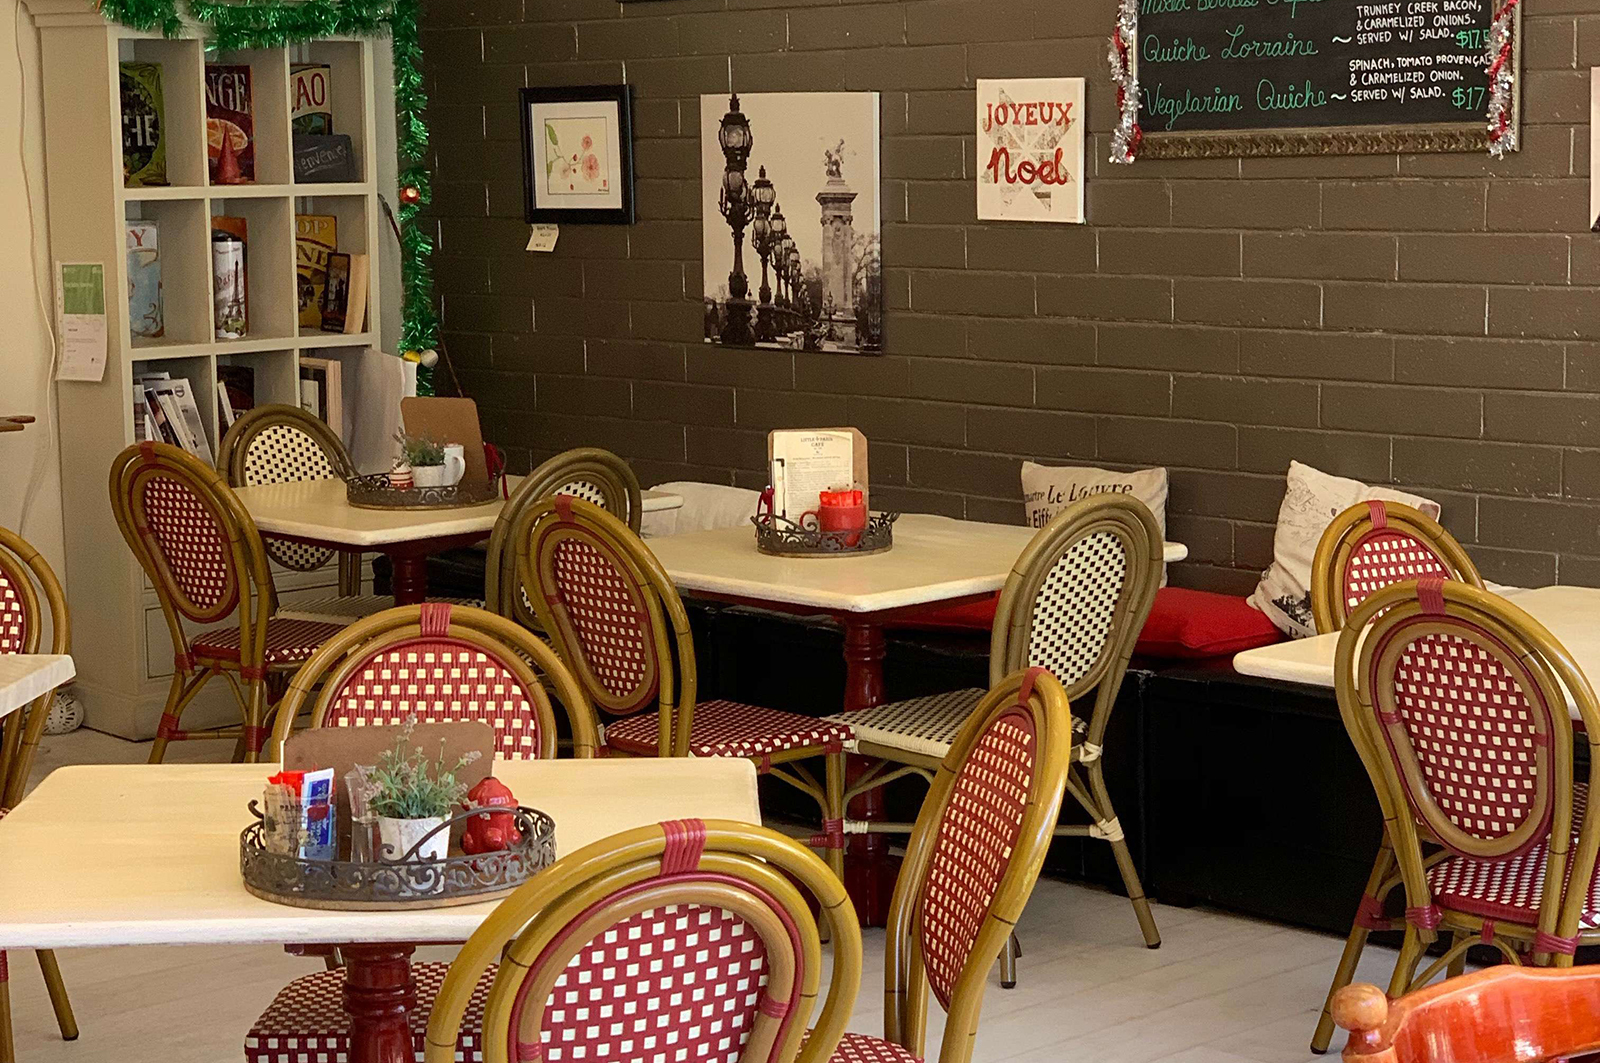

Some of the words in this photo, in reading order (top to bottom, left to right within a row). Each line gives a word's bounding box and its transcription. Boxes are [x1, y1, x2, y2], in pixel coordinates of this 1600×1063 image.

[1356, 3, 1401, 18] TRUNKEY
[1407, 1, 1439, 15] CREEK
[1443, 0, 1482, 13] BACON,
[1433, 14, 1476, 27] ONIONS.
[1143, 34, 1210, 62] Quiche
[1221, 24, 1319, 59] Lorraine
[1356, 31, 1392, 45] SERVED
[1398, 30, 1413, 43] W/
[1419, 28, 1455, 41] SALAD.
[1349, 57, 1395, 71] SPINACH,
[1397, 56, 1433, 68] TOMATO
[1349, 73, 1358, 86] &
[1361, 71, 1425, 86] CARAMELIZED
[1429, 70, 1464, 83] ONION.
[1257, 79, 1327, 110] Quiche
[1350, 88, 1387, 103] SERVED
[1392, 86, 1405, 104] W/
[1410, 86, 1446, 99] SALAD.
[1451, 86, 1485, 111] $17
[983, 102, 1073, 132] JOYEUX
